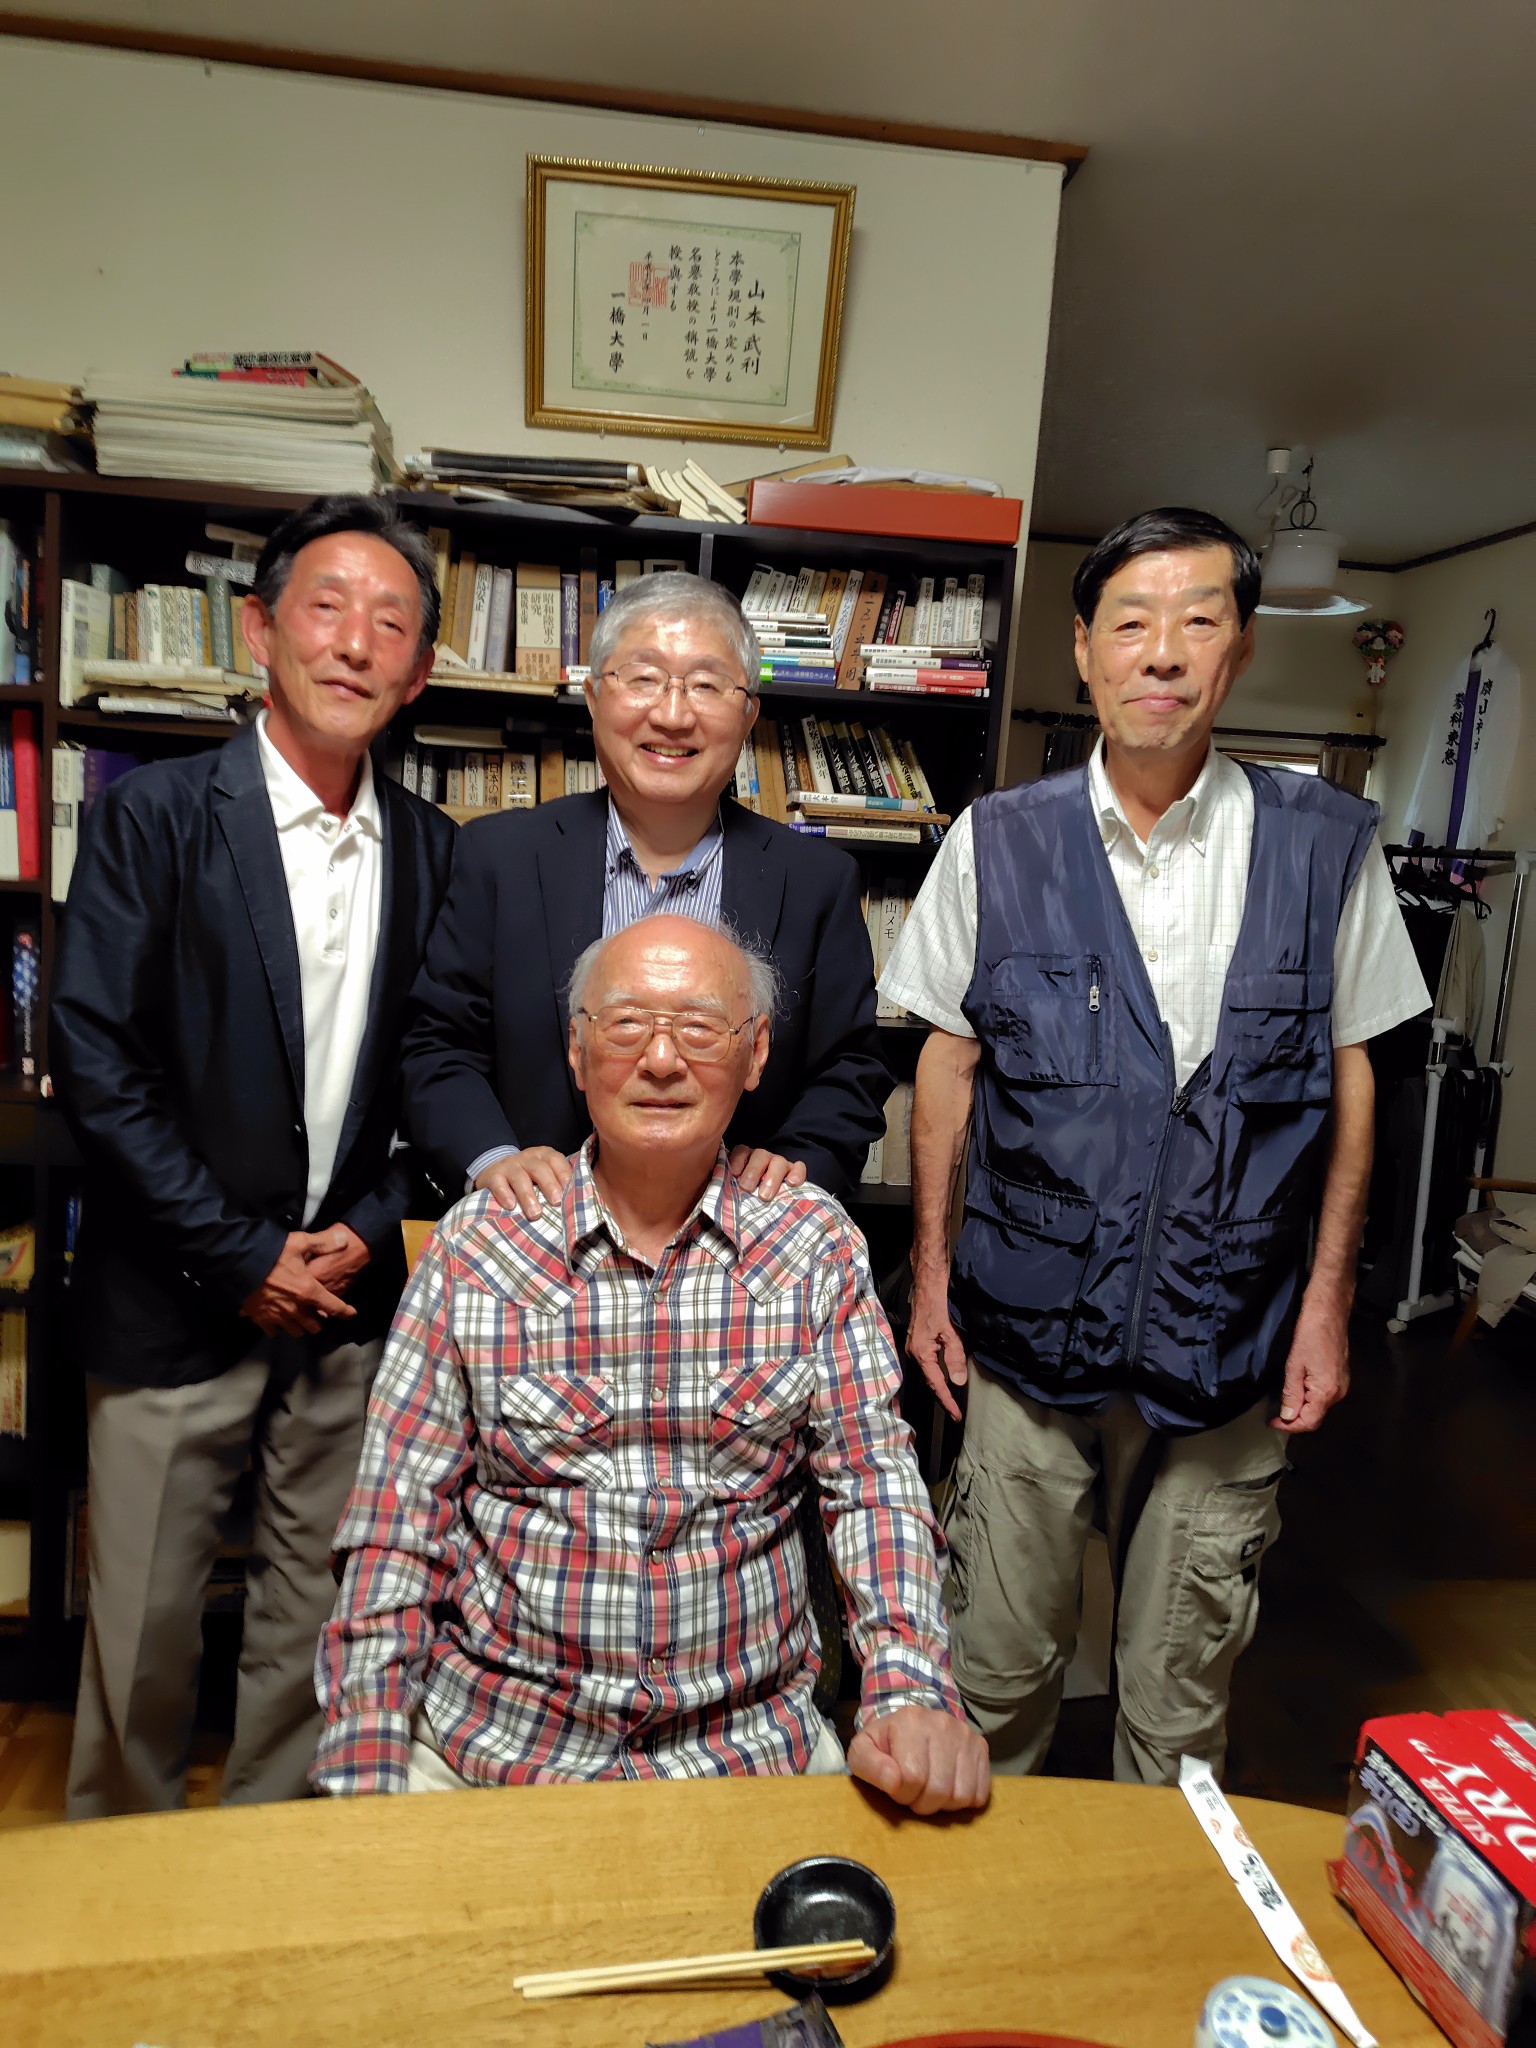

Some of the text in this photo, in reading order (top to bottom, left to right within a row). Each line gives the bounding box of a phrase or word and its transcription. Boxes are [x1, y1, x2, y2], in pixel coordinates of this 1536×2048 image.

[608, 290, 627, 374] 一橋大學
[740, 279, 766, 376] 山本武利
[531, 592, 542, 616] 研究
[543, 592, 554, 645] 昭和陸軍の
[884, 888, 898, 940] 杉山メモ
[1420, 1776, 1503, 1847] SUPER
